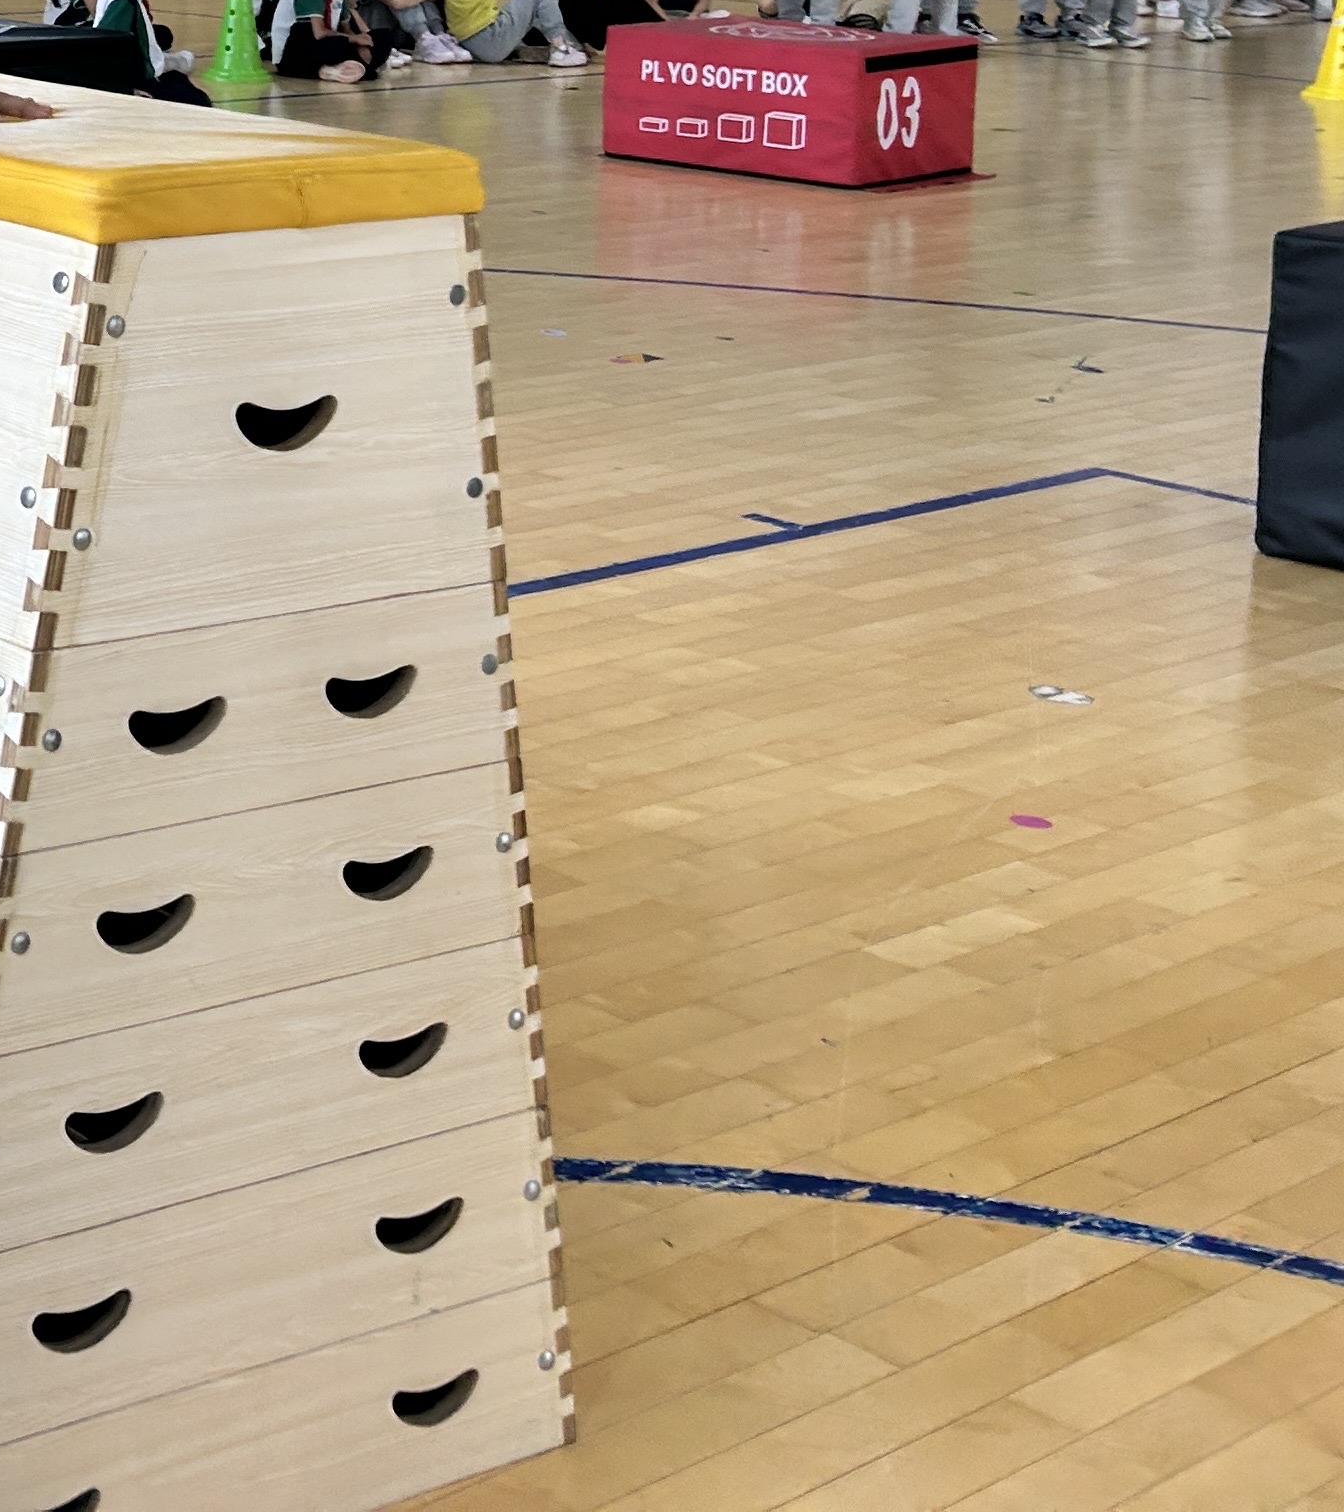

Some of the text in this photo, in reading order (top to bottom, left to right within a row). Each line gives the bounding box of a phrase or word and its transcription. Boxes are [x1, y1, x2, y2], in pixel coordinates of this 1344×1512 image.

[702, 64, 757, 92] SOFT
[762, 70, 809, 98] BOX
[876, 76, 923, 150] 03
